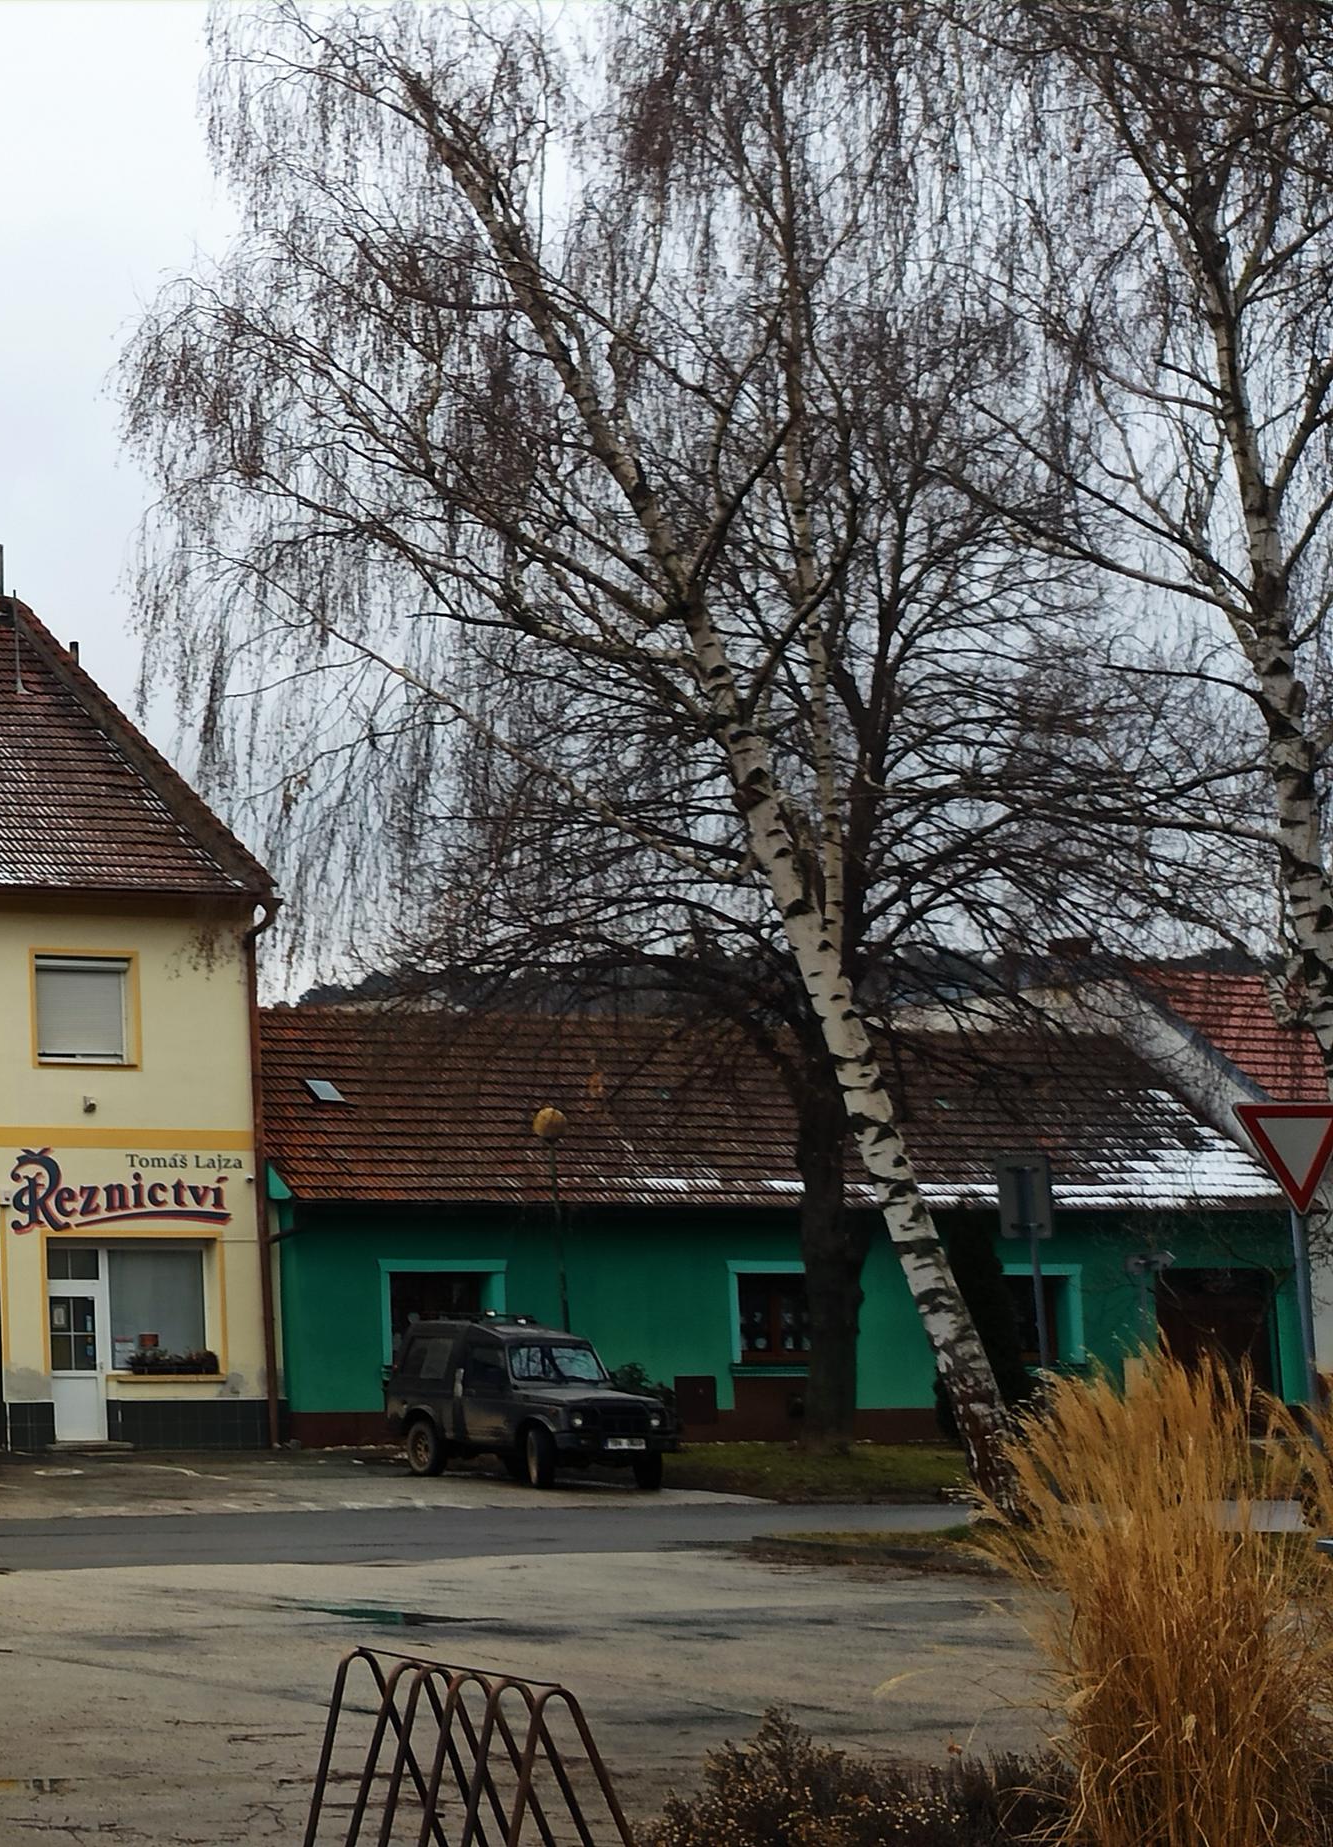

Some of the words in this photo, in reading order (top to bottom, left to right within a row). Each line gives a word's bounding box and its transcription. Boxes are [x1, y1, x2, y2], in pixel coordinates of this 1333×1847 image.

[125, 1153, 188, 1169] Tomáš
[194, 1154, 243, 1173] Lajza
[10, 1147, 231, 1234] Řeznictví
